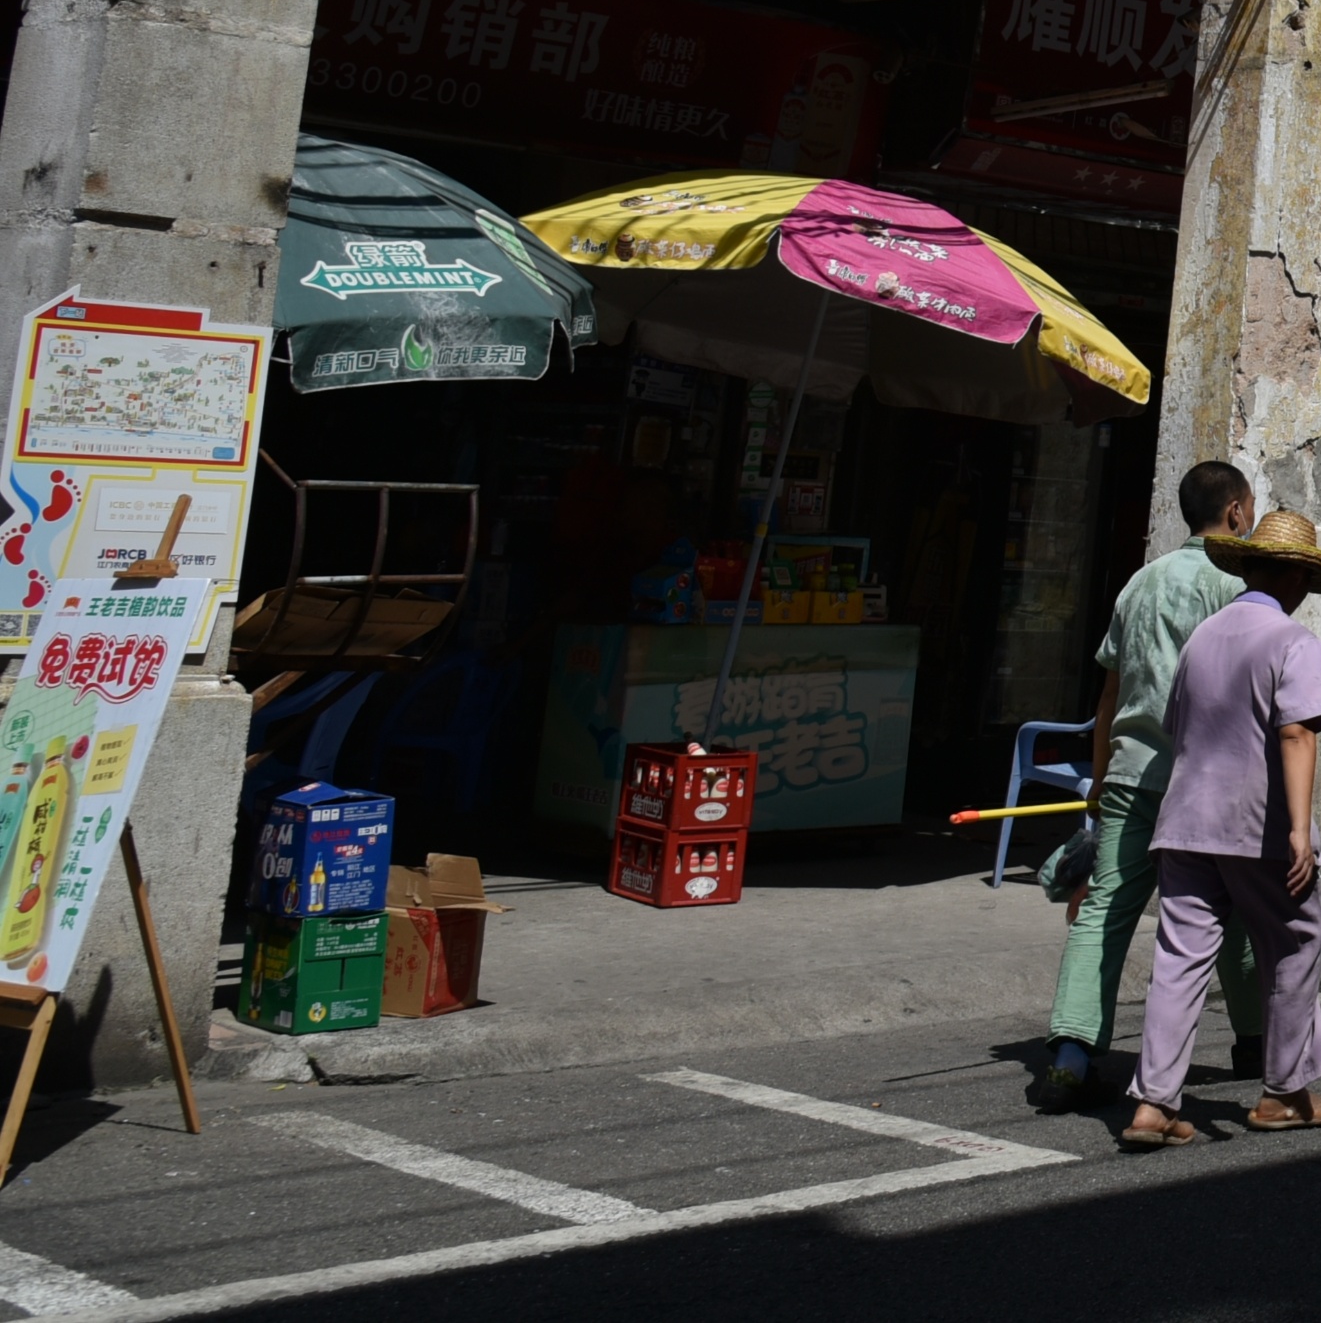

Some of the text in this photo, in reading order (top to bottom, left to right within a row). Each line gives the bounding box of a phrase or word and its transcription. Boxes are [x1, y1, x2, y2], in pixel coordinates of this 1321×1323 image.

[580, 88, 731, 141] 好味情更久
[352, 245, 424, 267] 绿箭
[326, 270, 475, 288] DOUBLEMINT
[313, 349, 399, 377] 清新口气
[437, 344, 527, 366] 你我更亲近
[85, 596, 188, 618] 王老吉植韵饮品
[37, 634, 167, 687] 免费试饮
